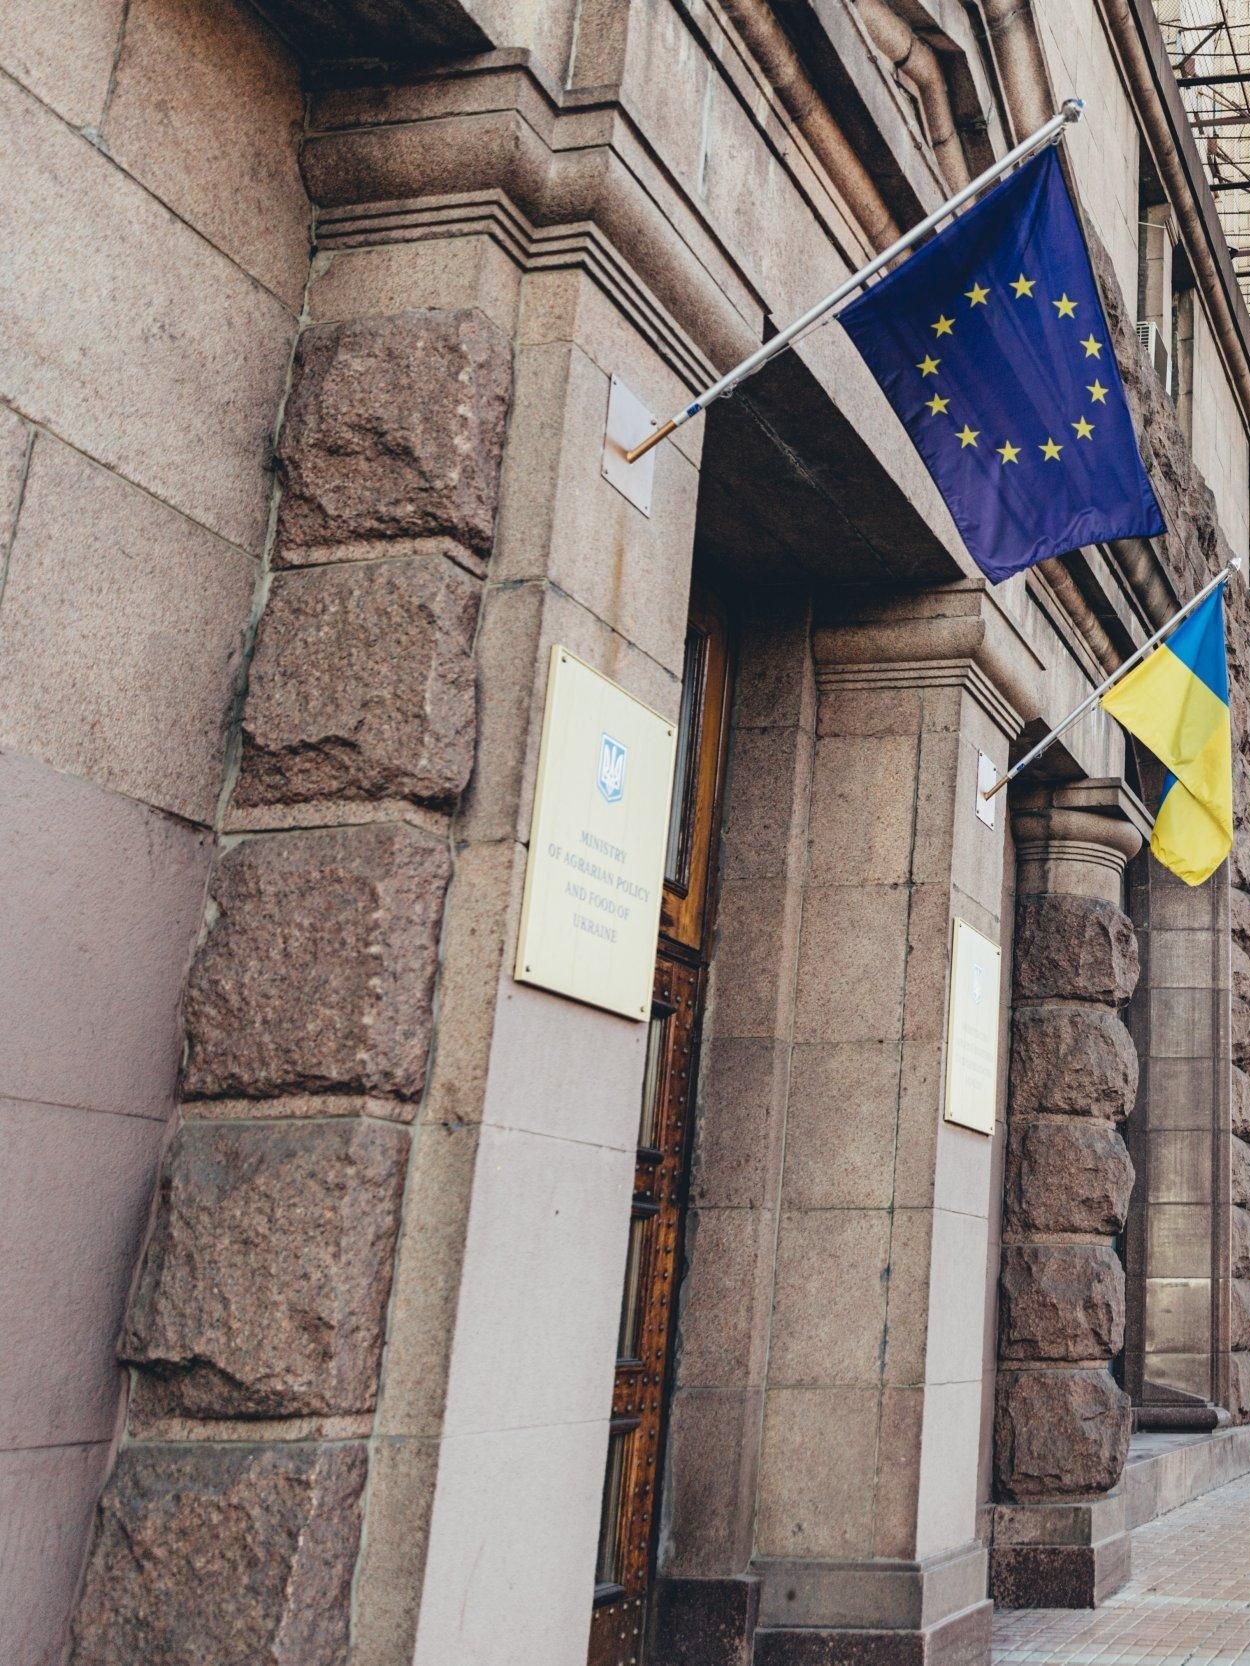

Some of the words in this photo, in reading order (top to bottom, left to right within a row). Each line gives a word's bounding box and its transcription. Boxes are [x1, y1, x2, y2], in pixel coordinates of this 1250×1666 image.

[579, 830, 628, 864] MINISTRY
[548, 843, 562, 860] OF
[563, 852, 614, 886] AGRARIAN
[616, 876, 650, 902] POLICY
[564, 881, 587, 901] AND
[588, 891, 616, 914] FOOD
[617, 905, 631, 920] OF
[572, 913, 618, 943] UKRAINE
